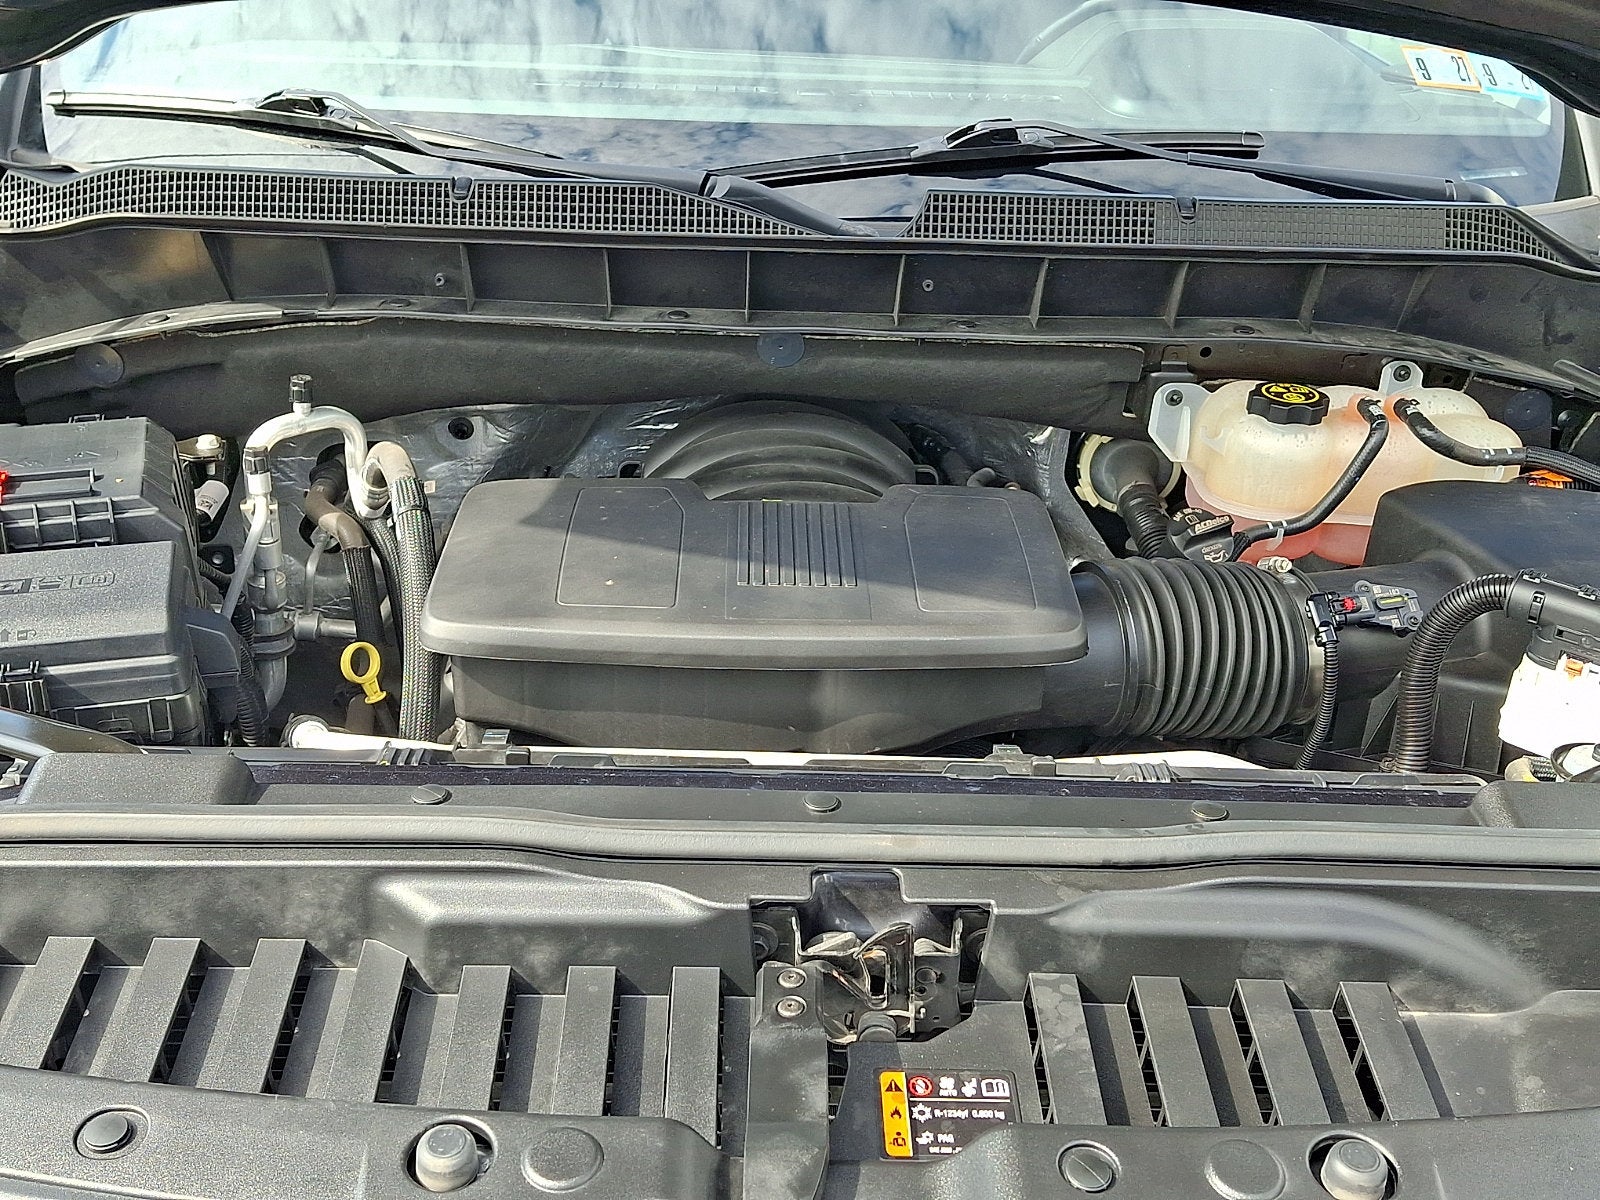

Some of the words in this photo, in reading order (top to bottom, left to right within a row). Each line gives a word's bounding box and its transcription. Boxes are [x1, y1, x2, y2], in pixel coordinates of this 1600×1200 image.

[1415, 57, 1431, 81] 9
[1451, 55, 1471, 82] 27
[1482, 63, 1498, 86] 9
[1194, 515, 1230, 532] ACDelco
